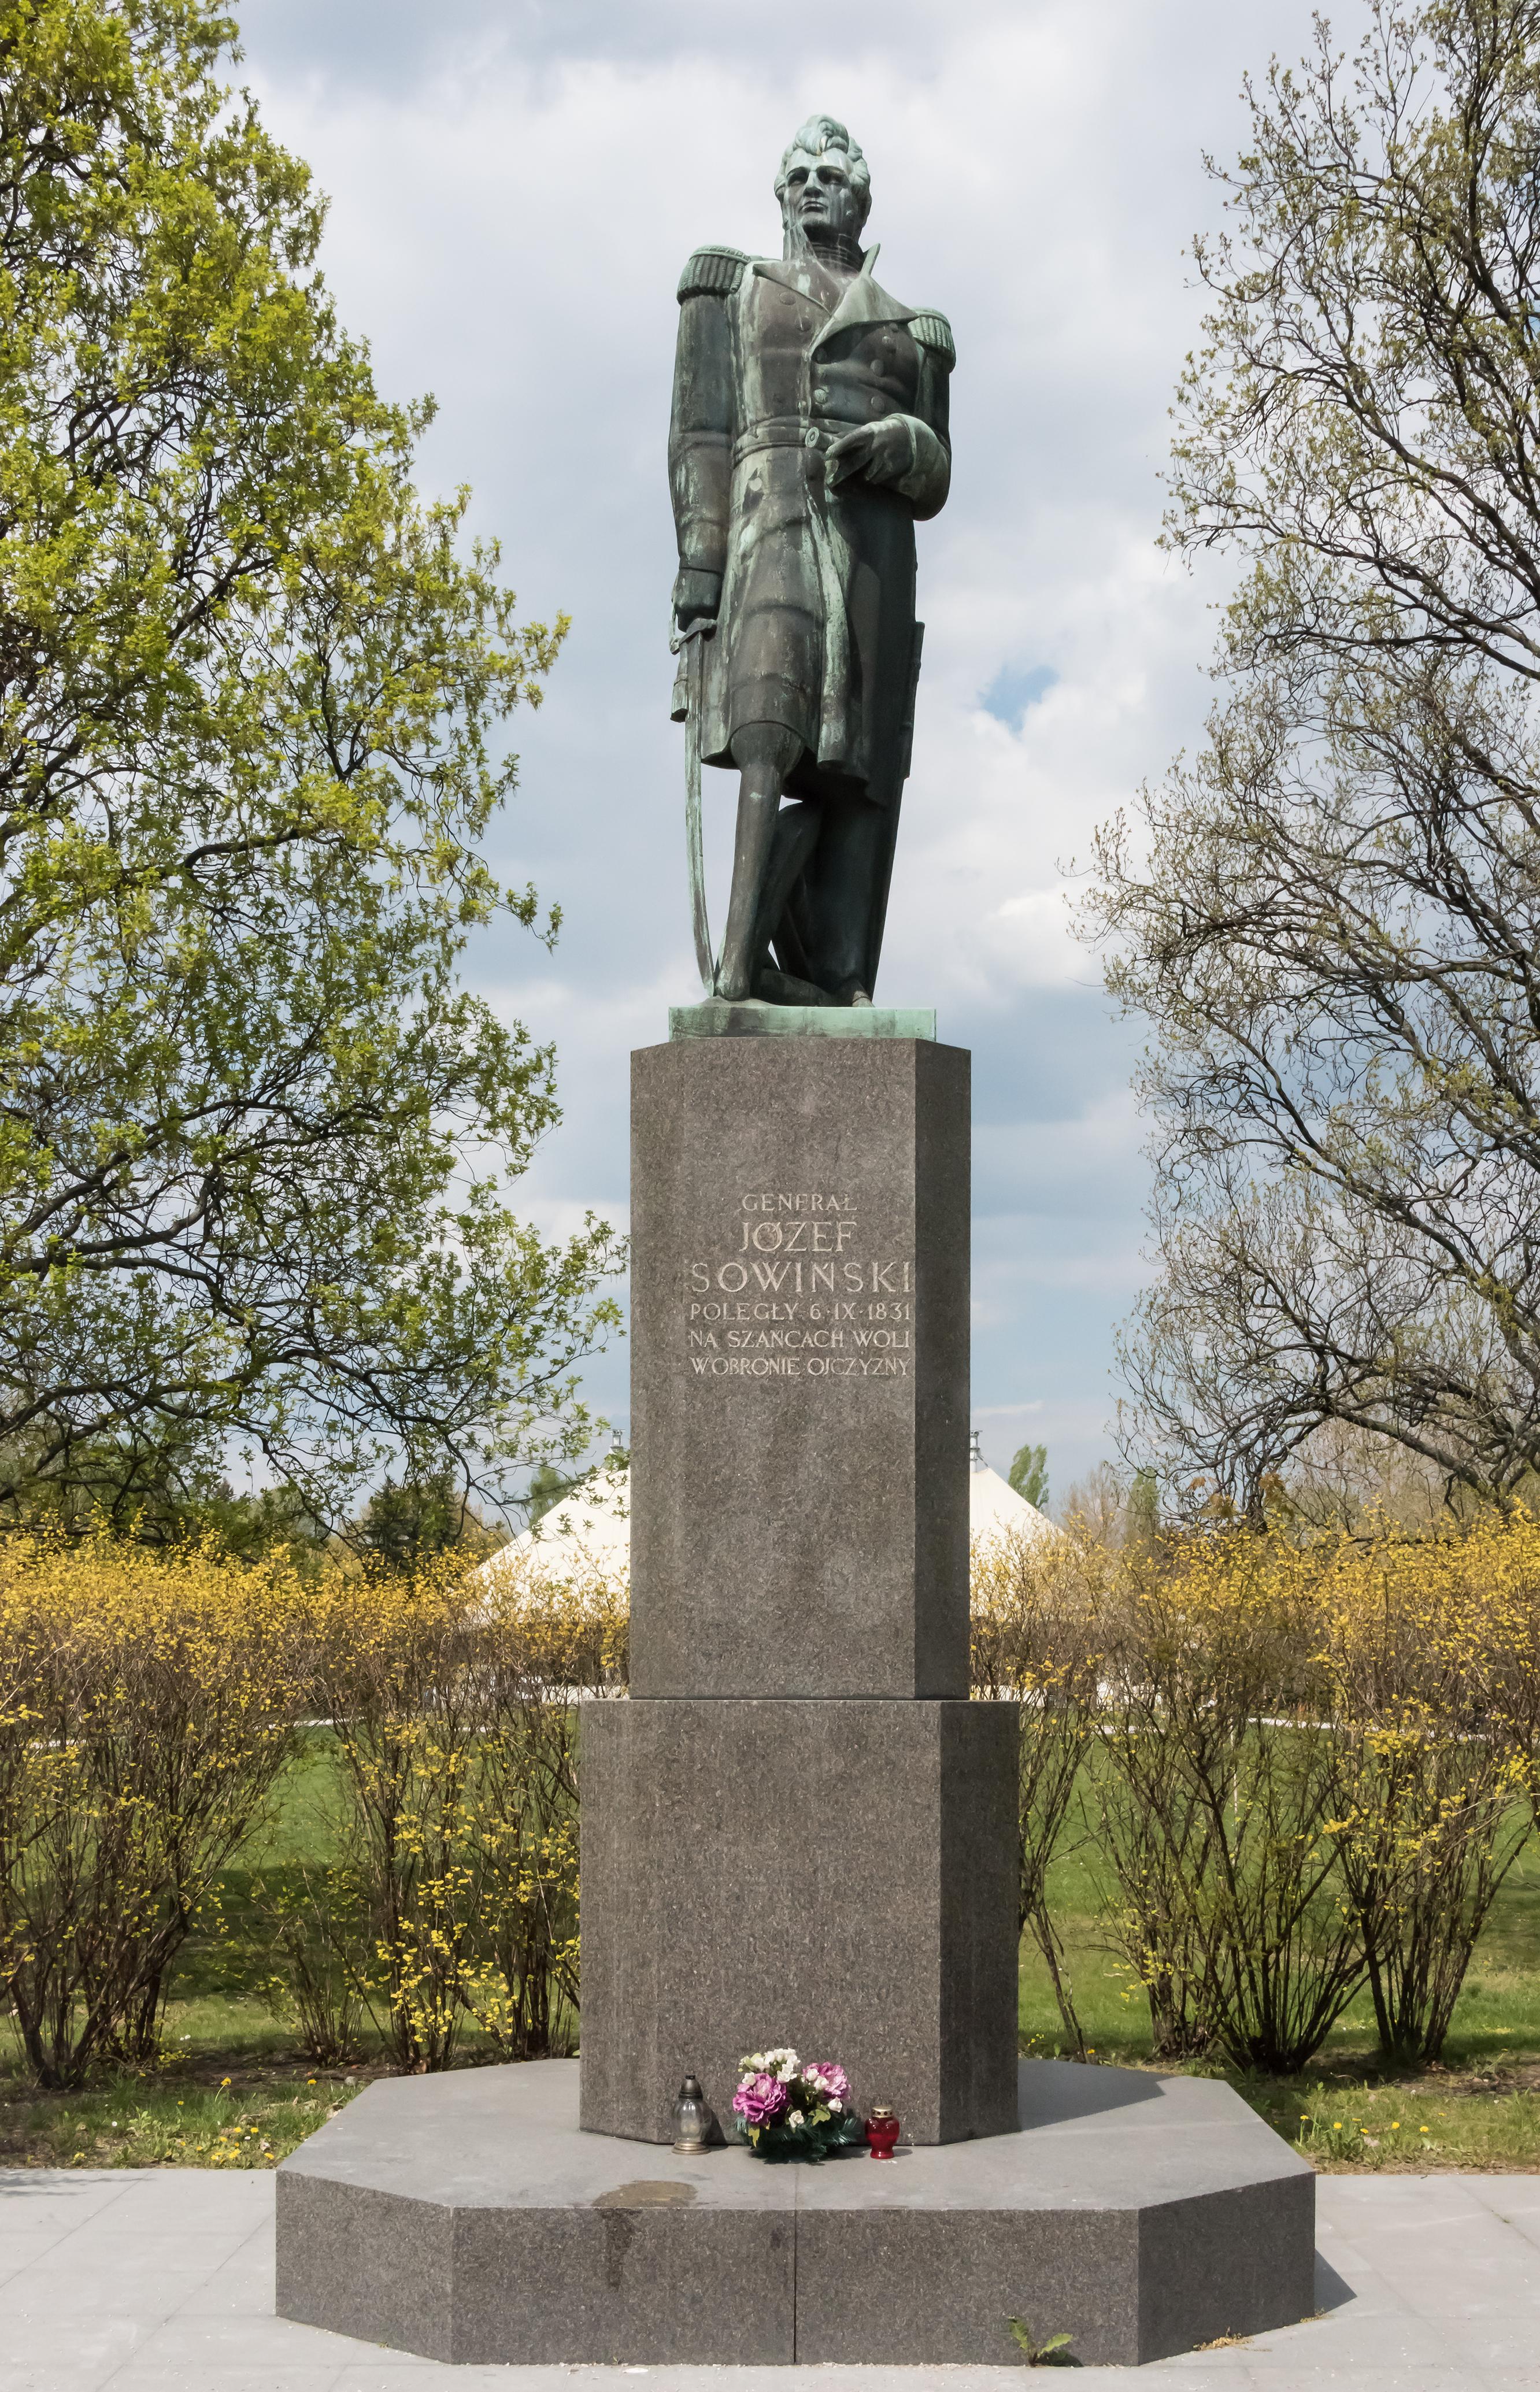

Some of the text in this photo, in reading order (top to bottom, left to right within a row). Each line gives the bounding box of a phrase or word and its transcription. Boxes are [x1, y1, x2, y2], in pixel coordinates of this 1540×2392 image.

[692, 1261, 910, 1293] SOWIŃSKI
[690, 1302, 799, 1320] POLEGŁY
[690, 1330, 719, 1348] NA
[851, 1330, 910, 1347] WOLI
[808, 1357, 912, 1375] OJCZYZNY
